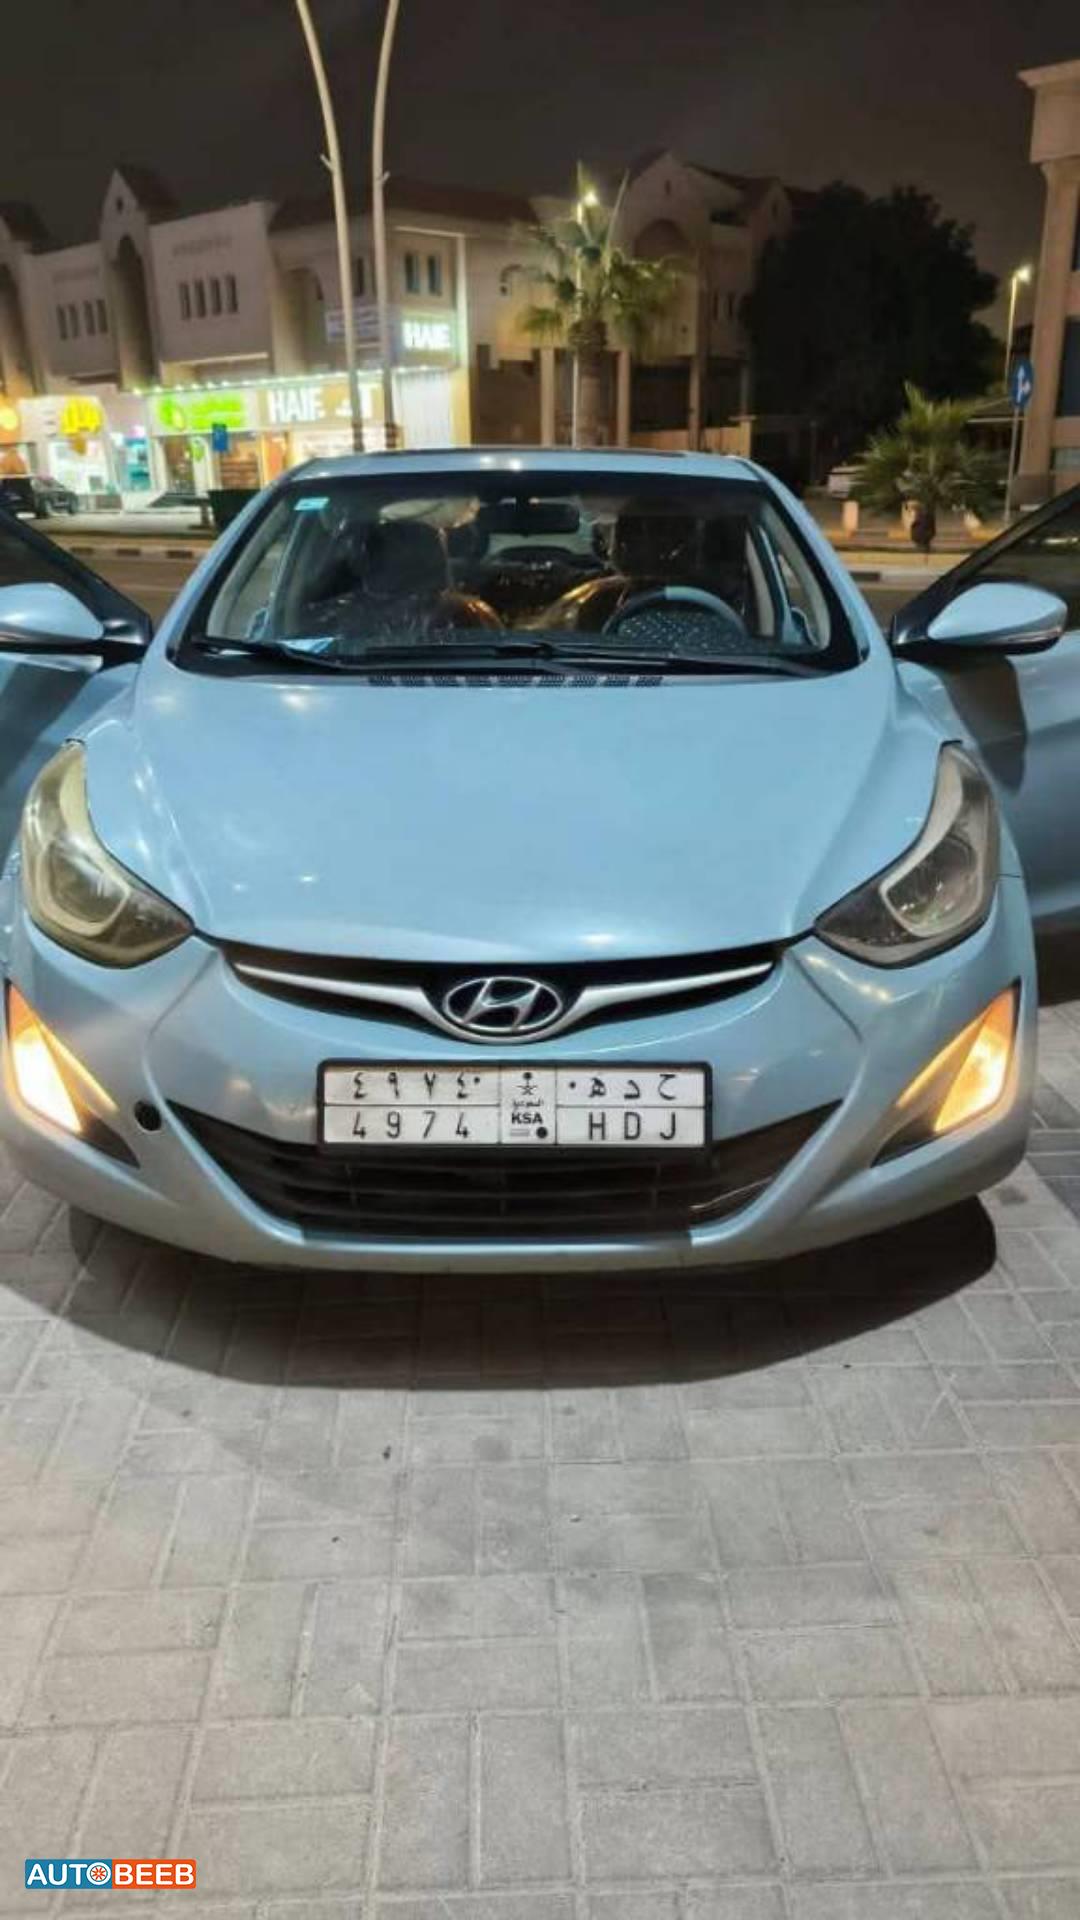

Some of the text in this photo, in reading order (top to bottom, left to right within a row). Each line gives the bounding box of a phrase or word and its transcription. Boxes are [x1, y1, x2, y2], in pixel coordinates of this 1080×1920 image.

[352, 1110, 470, 1139] 4974
[511, 1112, 544, 1125] KSA
[588, 1111, 677, 1141] HDJ
